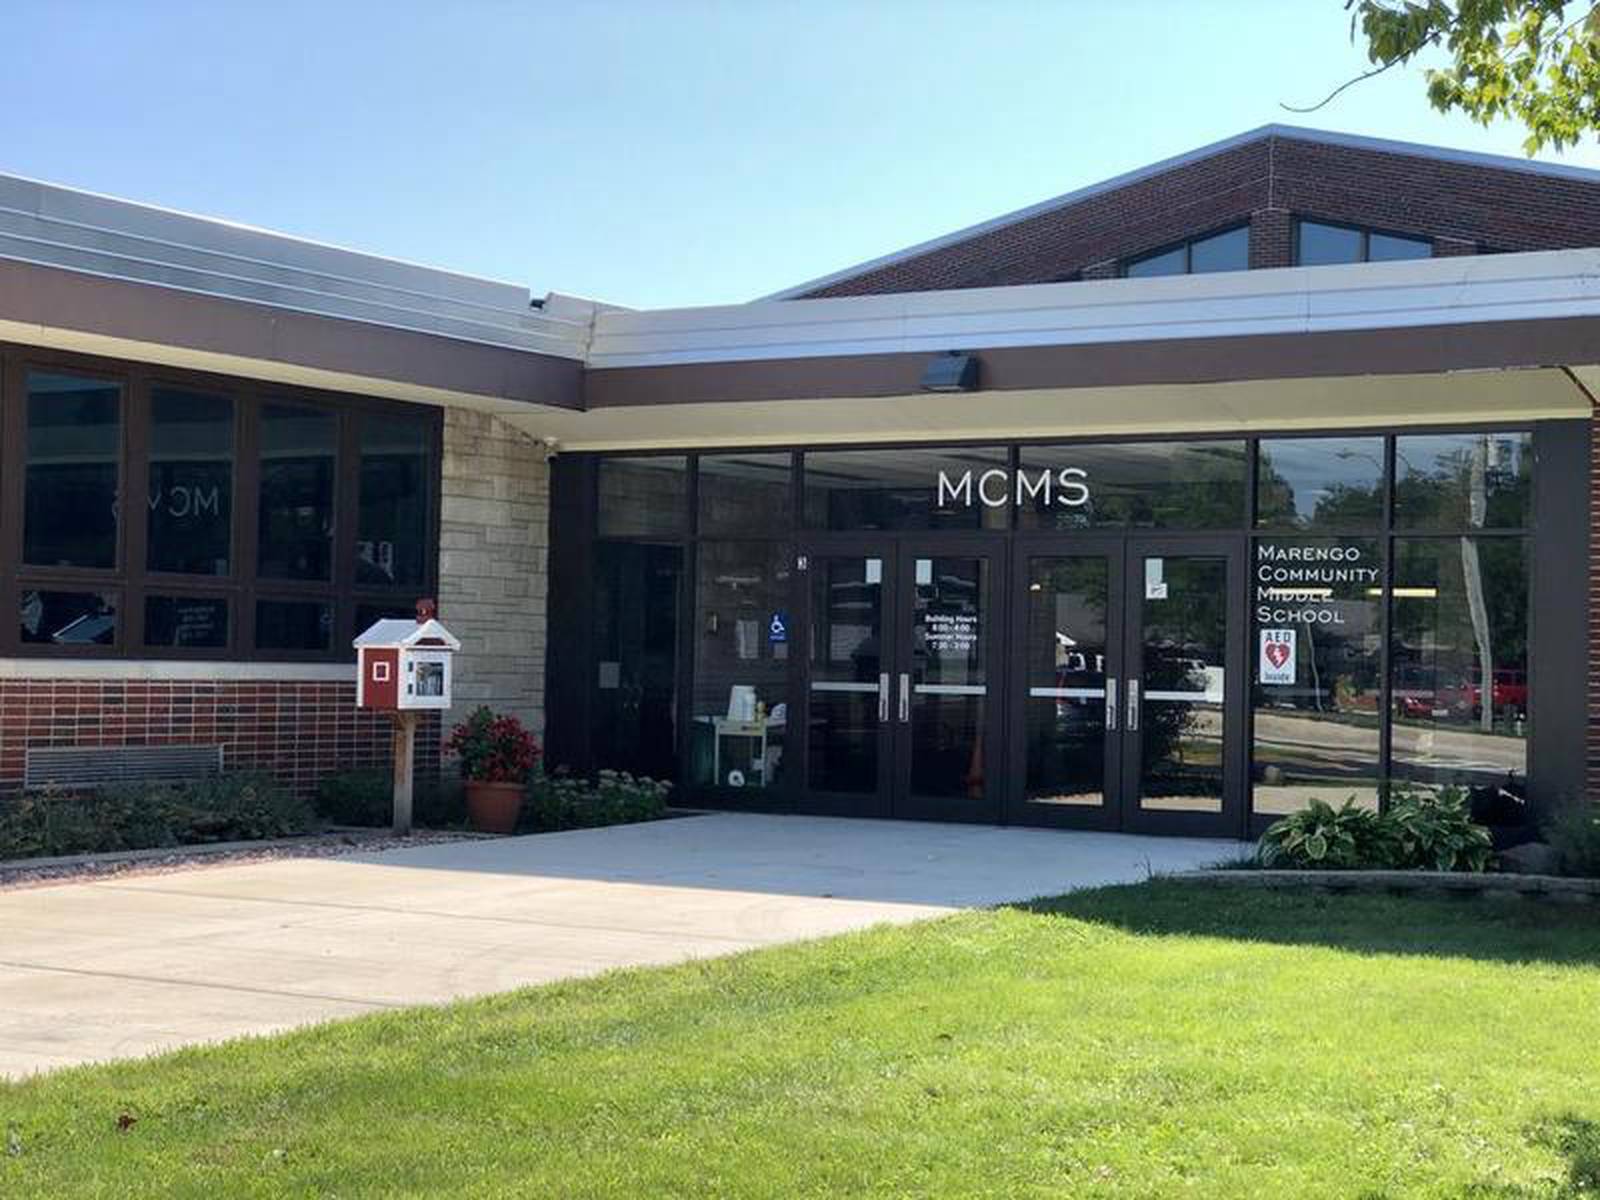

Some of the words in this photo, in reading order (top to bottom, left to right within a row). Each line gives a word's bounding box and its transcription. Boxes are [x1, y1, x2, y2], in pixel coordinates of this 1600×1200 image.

[938, 468, 1089, 506] MCMS
[1257, 545, 1360, 561] MARENGO
[1258, 565, 1379, 581] COMMUNITY
[1257, 607, 1344, 623] SCHOOL
[1265, 631, 1291, 642] AED
